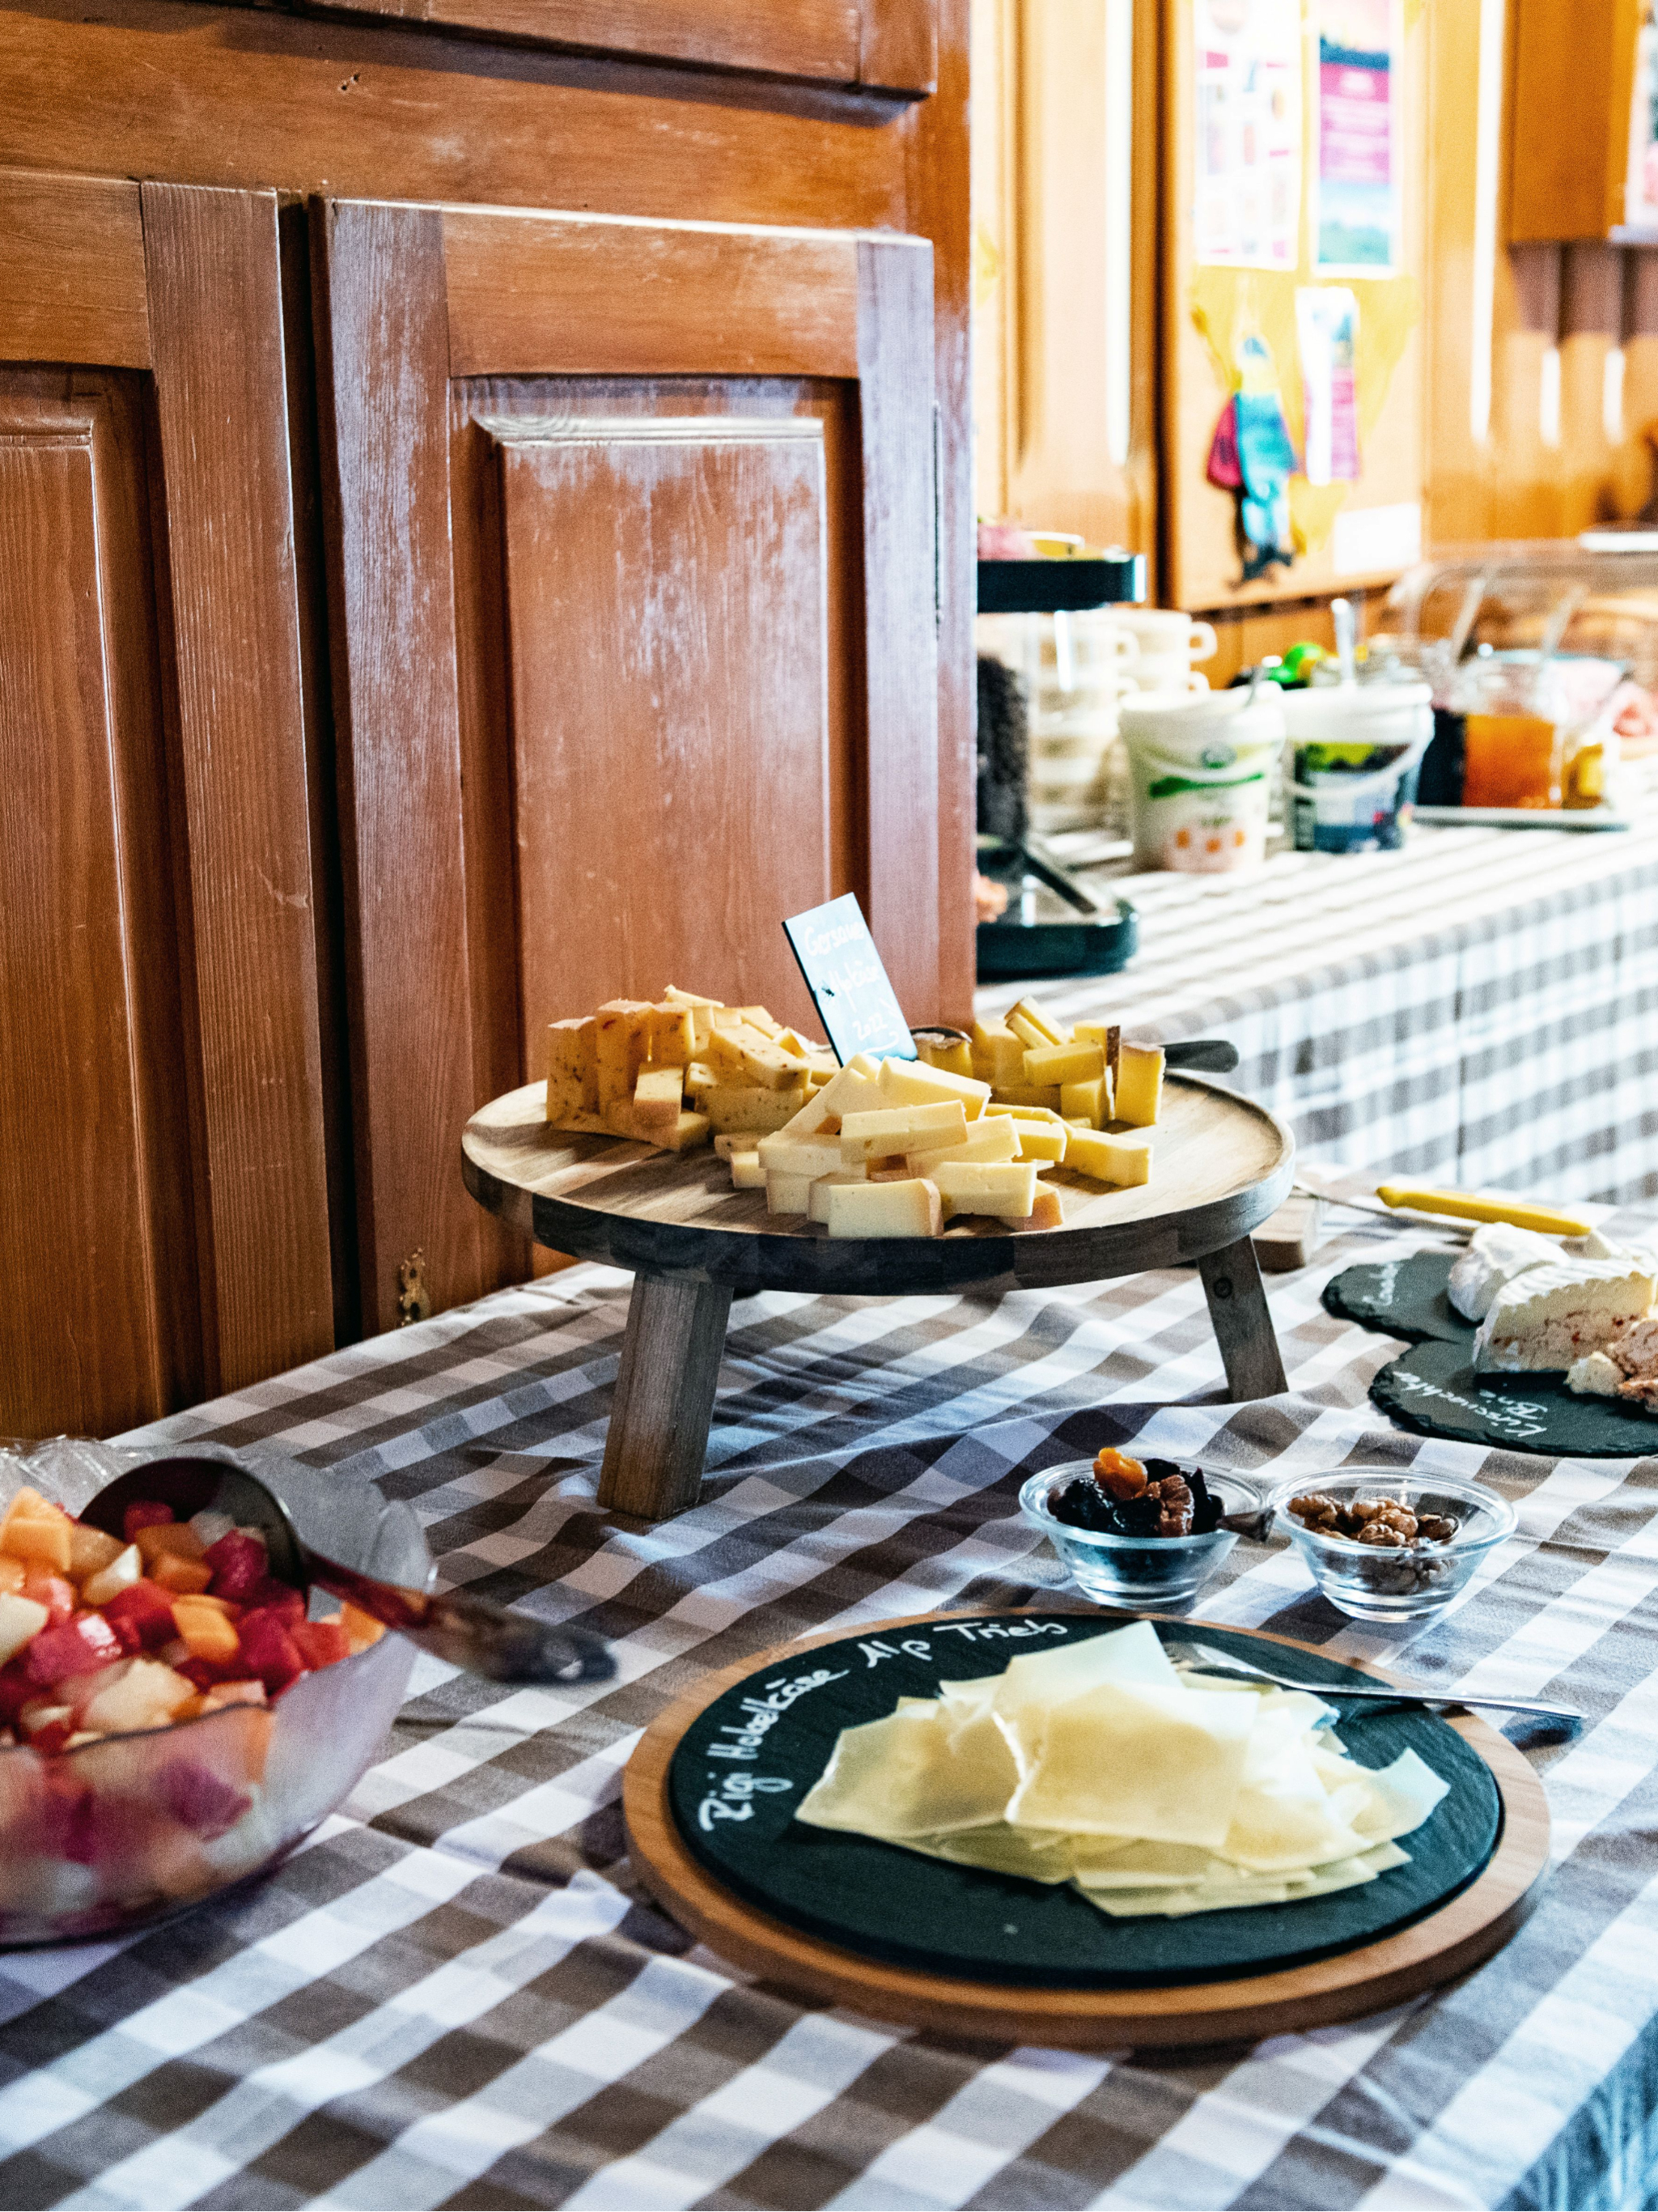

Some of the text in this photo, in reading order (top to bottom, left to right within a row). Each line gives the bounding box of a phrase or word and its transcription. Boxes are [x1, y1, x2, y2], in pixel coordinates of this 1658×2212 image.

[852, 1012, 888, 1042] 2022
[1478, 1389, 1549, 1420] Brie
[698, 1771, 794, 1831] Rigi
[857, 1638, 933, 1668] Alp
